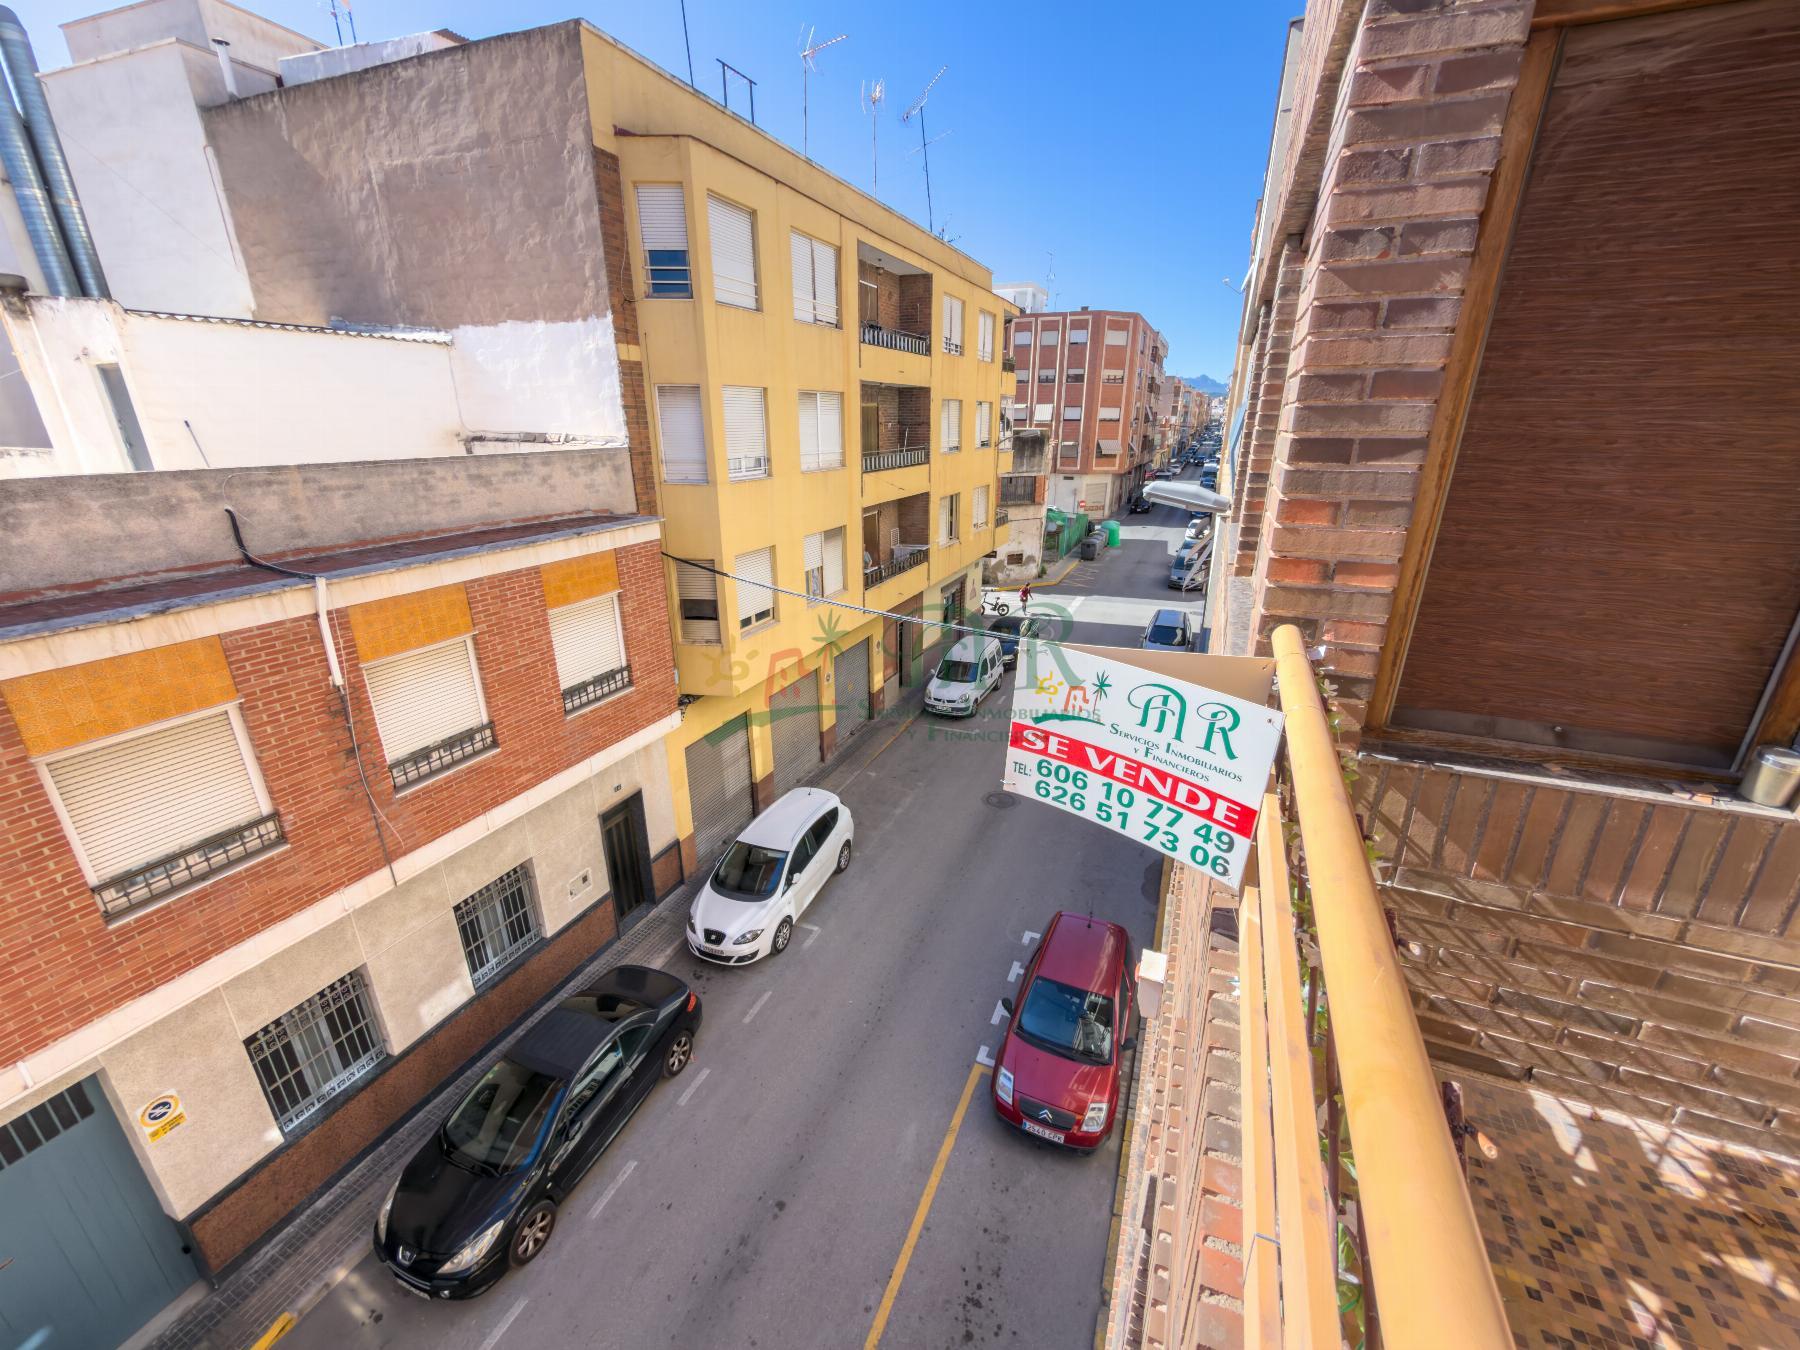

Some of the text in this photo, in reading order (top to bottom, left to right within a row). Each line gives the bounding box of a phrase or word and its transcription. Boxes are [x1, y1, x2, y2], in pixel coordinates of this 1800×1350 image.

[1013, 759, 1235, 853] TEL: 606 10 77 49
[1022, 730, 1241, 828] SE VENDE
[1034, 780, 1231, 877] 626 51 73 06
